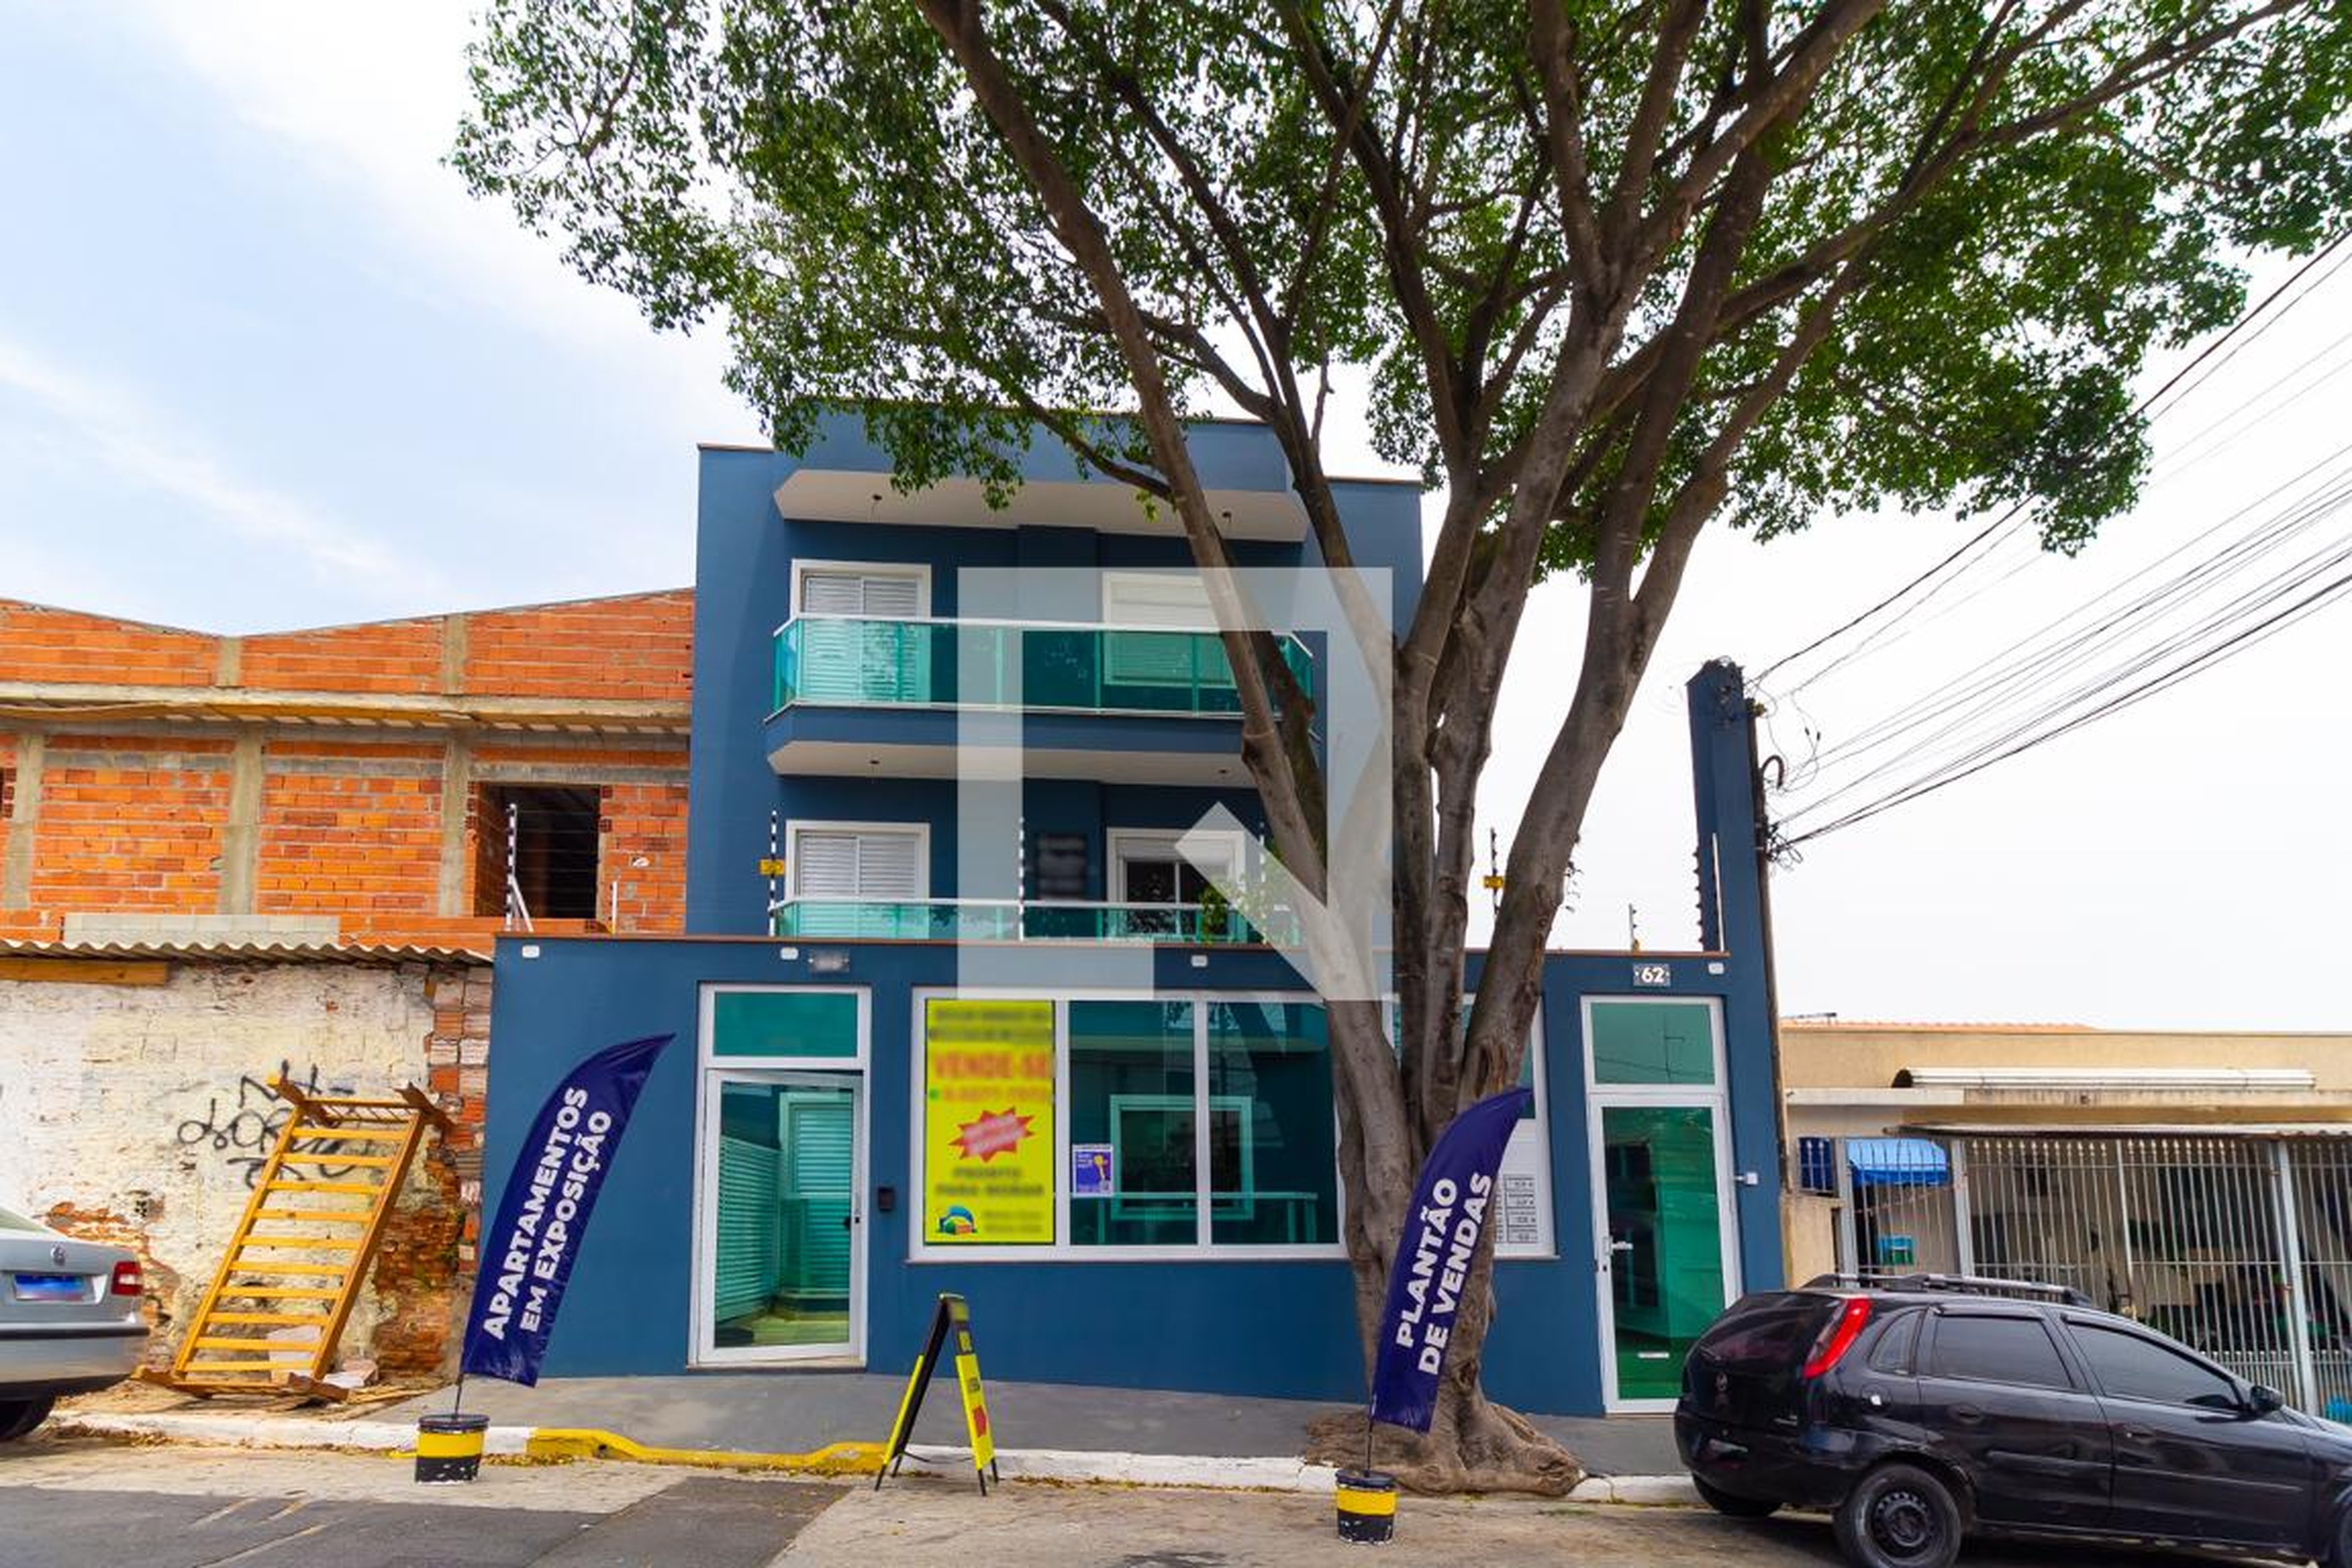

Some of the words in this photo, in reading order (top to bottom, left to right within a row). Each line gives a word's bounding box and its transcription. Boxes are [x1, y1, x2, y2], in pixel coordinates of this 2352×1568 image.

[1642, 967, 1665, 983] 62
[484, 1087, 588, 1340] APARTAMENTOS
[521, 1285, 547, 1333] EM
[534, 1111, 611, 1280] EXPOSIÇÃO
[1396, 1178, 1458, 1348] PLANTÃO
[1432, 1172, 1492, 1314] VENDAS
[1418, 1324, 1449, 1375] DE
